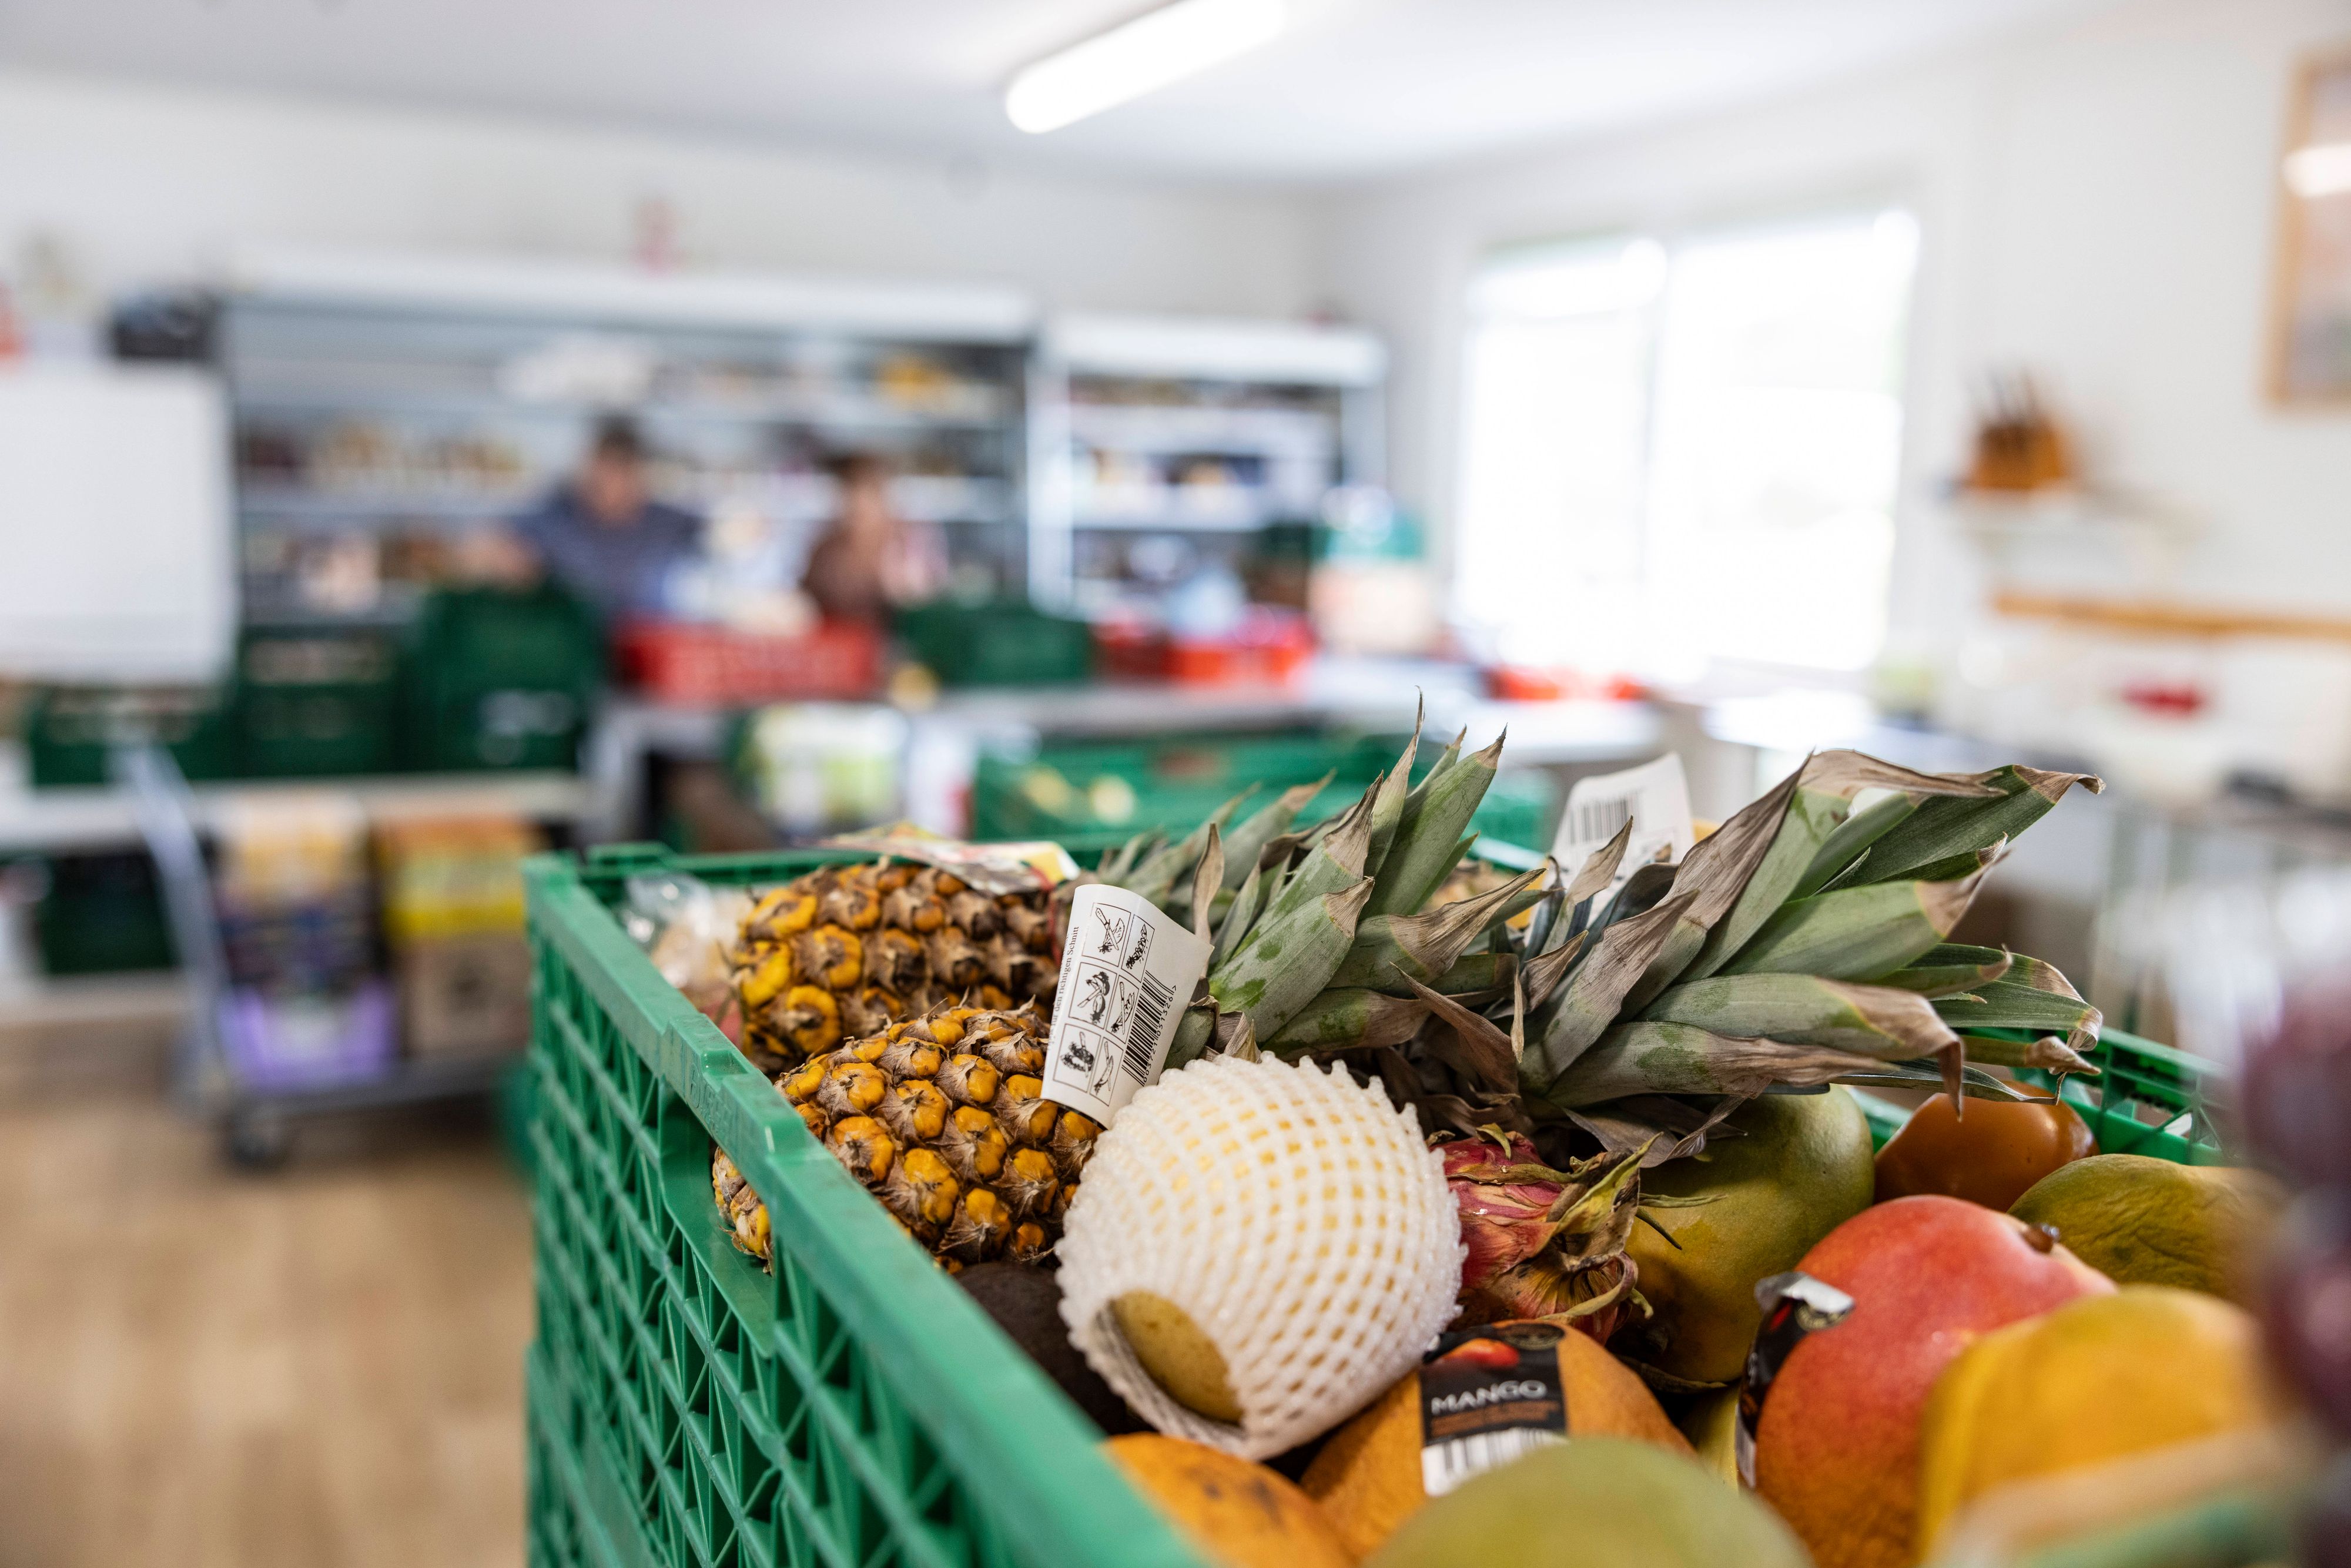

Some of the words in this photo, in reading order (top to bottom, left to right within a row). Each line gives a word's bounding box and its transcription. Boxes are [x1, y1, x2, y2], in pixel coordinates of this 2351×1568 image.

[1054, 996, 1063, 1011] den
[1059, 957, 1072, 994] richtigen
[1067, 926, 1079, 956] Schnitt
[1431, 1380, 1548, 1415] MANGO
